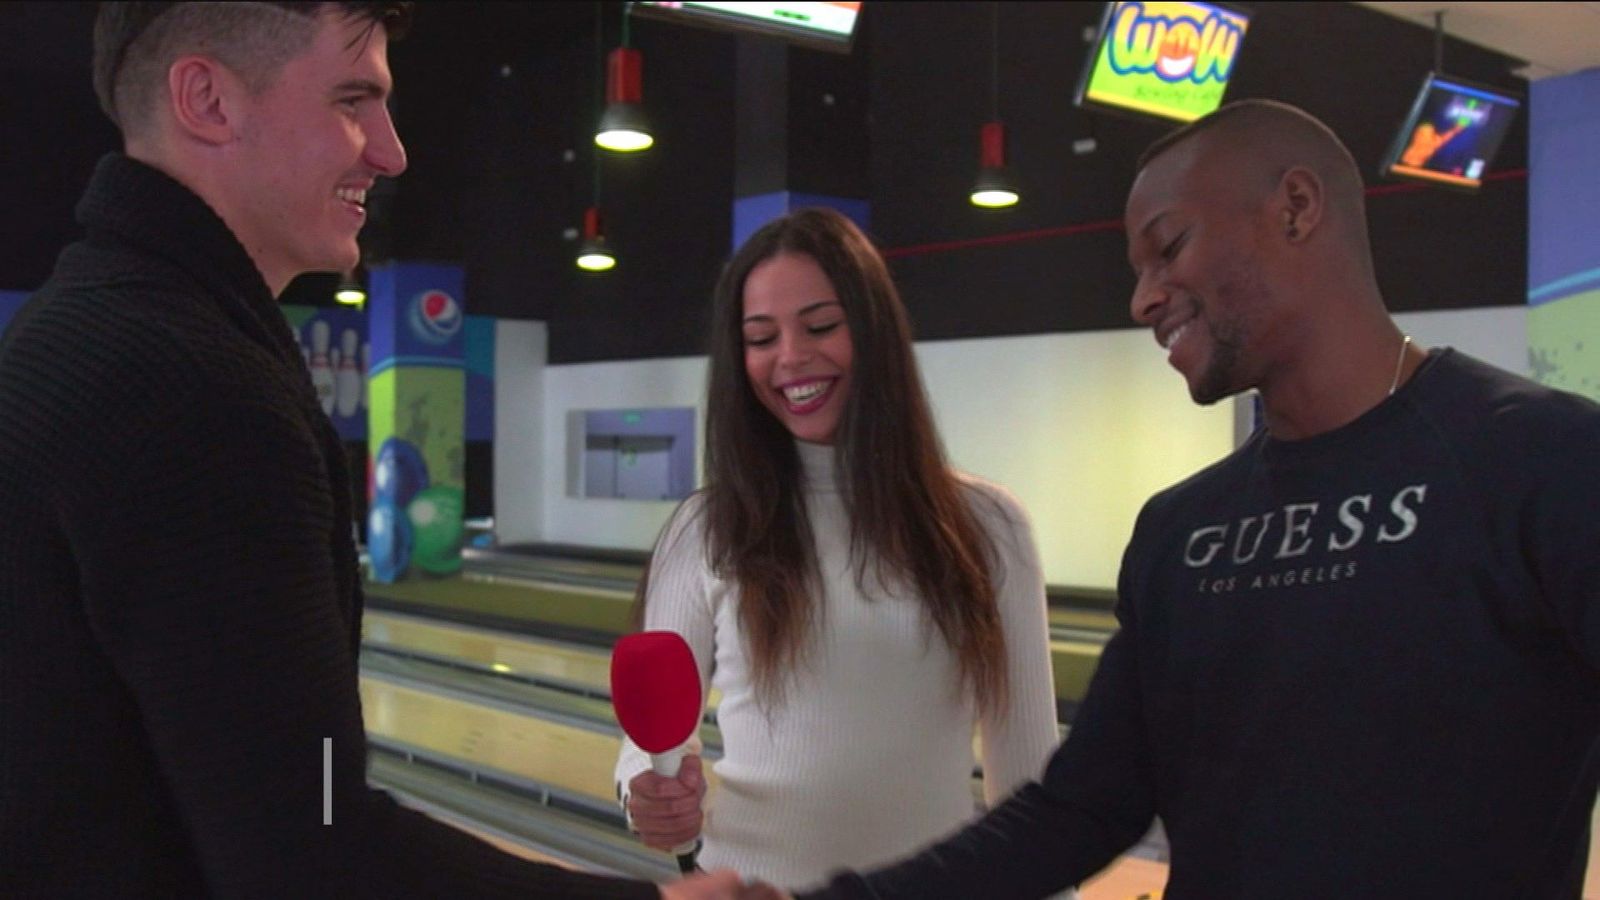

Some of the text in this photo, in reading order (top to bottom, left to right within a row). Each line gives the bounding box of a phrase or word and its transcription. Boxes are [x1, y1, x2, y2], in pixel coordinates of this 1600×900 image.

[1109, 2, 1243, 84] WOW
[1184, 484, 1427, 567] GUESS
[1199, 561, 1358, 593] LOS ANGELES
